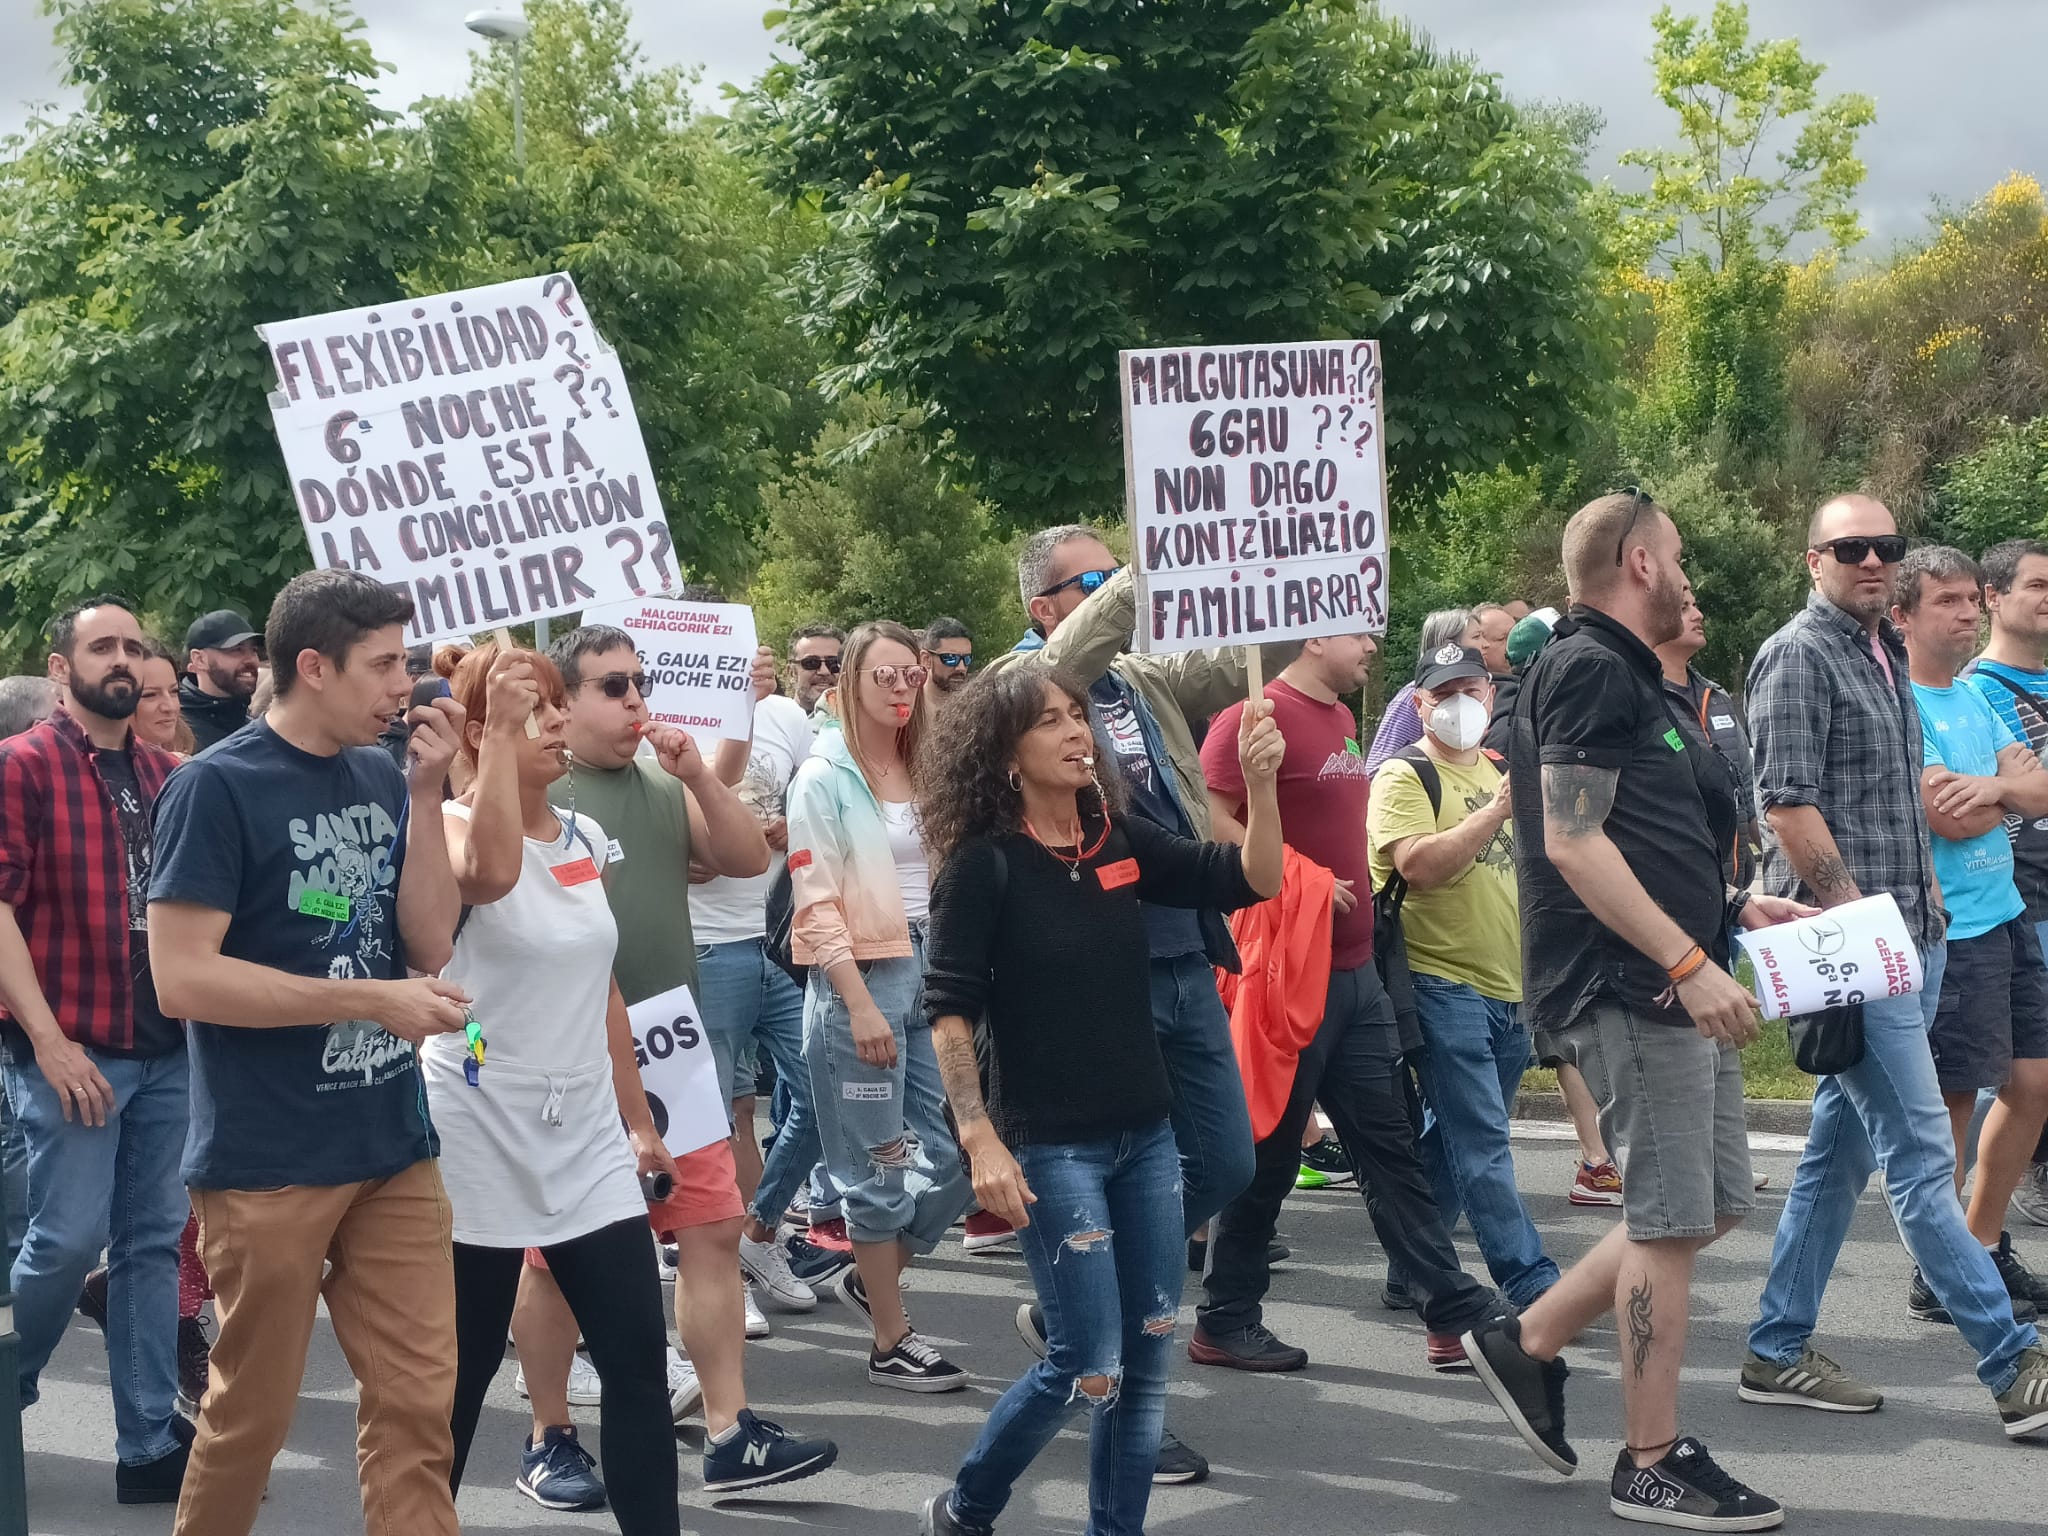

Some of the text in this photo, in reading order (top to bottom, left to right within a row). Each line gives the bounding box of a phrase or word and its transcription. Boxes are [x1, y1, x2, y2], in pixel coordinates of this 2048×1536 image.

[400, 378, 546, 448] NOCHE
[299, 417, 594, 523] DÓNDE ESTÁ
[1155, 459, 1337, 514] NON DAGO
[321, 467, 644, 571] LA CONCILIACIÓN
[1146, 500, 1375, 570] KONTZILIAZIO
[624, 617, 733, 635] GEHIAGORIK EZ!
[641, 608, 719, 623] MALGUTASUN
[657, 652, 709, 669] GAUA
[716, 656, 747, 672] EZ!
[650, 669, 713, 688] NOCHE
[717, 675, 750, 691] NO!
[648, 712, 722, 728] LEXIBILIDAD!
[289, 802, 397, 860] SANTA
[1840, 962, 1859, 982] 6.
[1770, 972, 1788, 999] MÁS
[316, 1082, 337, 1092] VENICE
